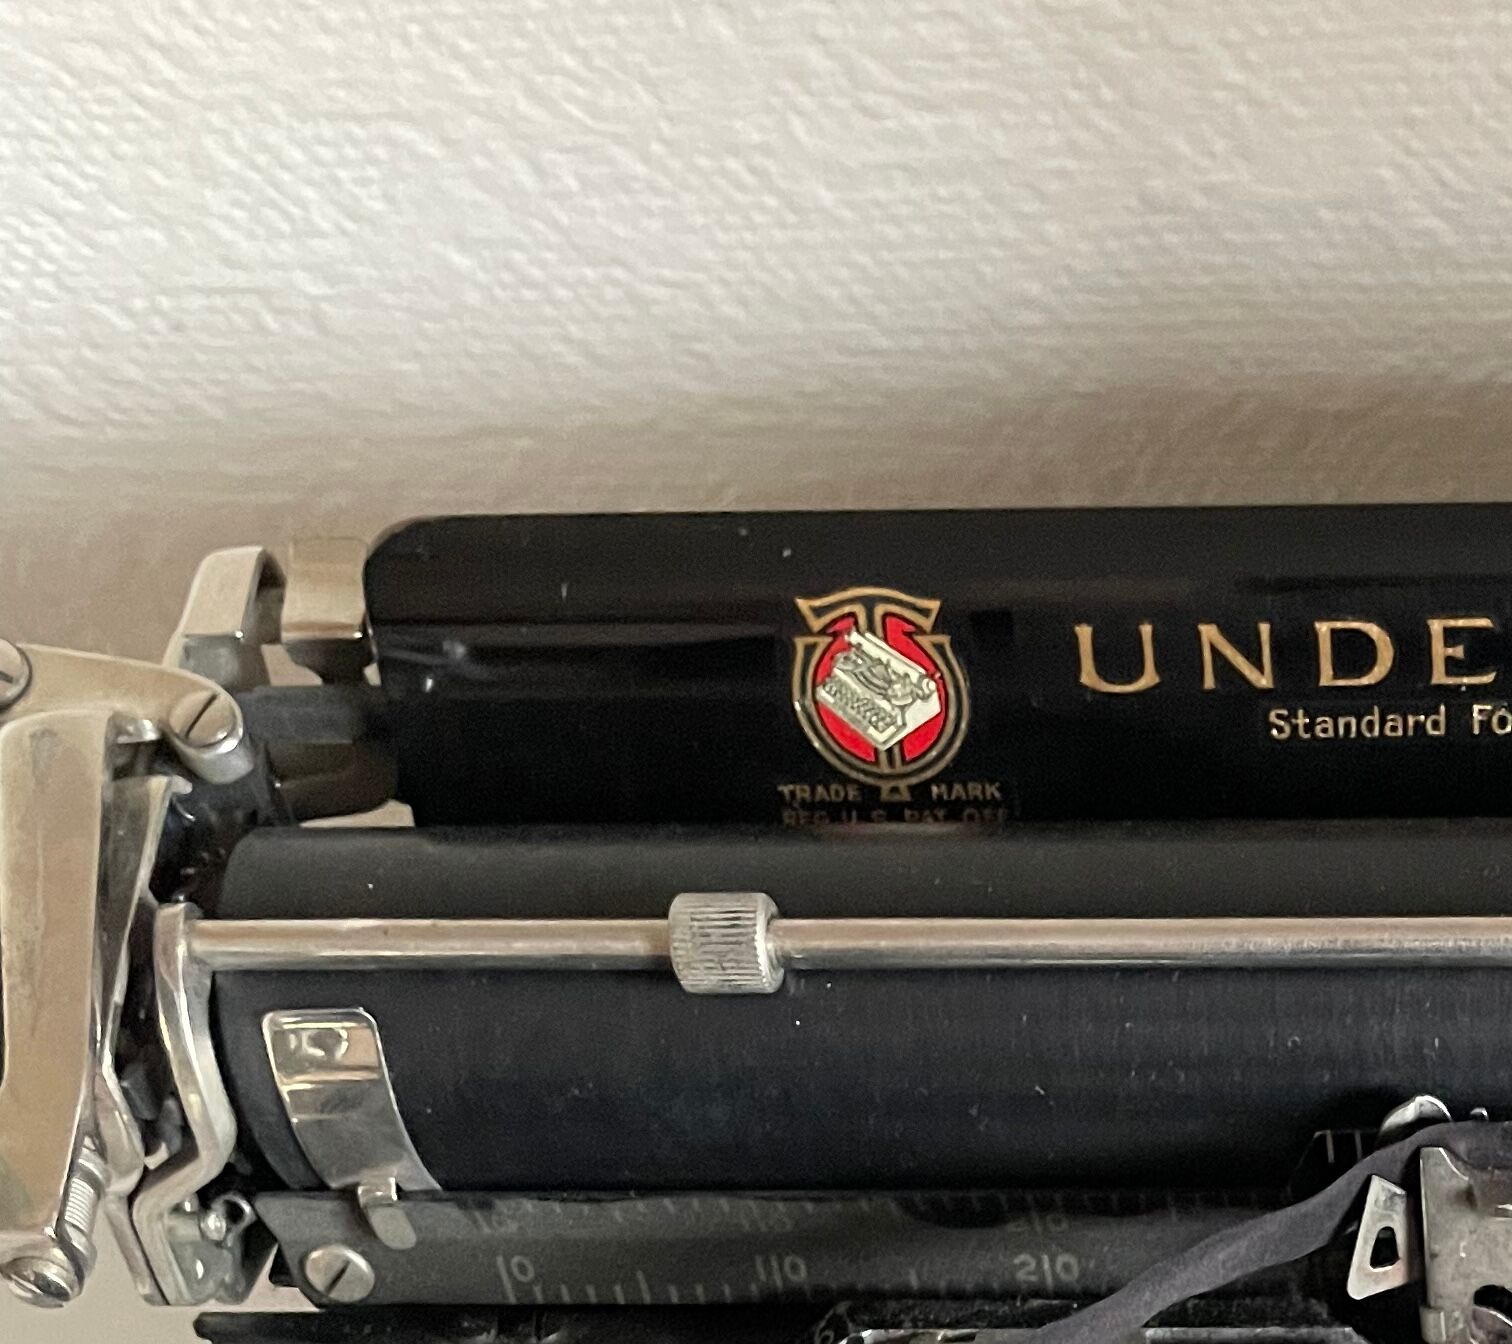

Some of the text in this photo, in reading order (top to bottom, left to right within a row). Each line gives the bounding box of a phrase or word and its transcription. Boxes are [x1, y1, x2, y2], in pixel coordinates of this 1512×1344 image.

[1269, 703, 1447, 742] Standard
[777, 781, 1002, 803] TRADE MARK
